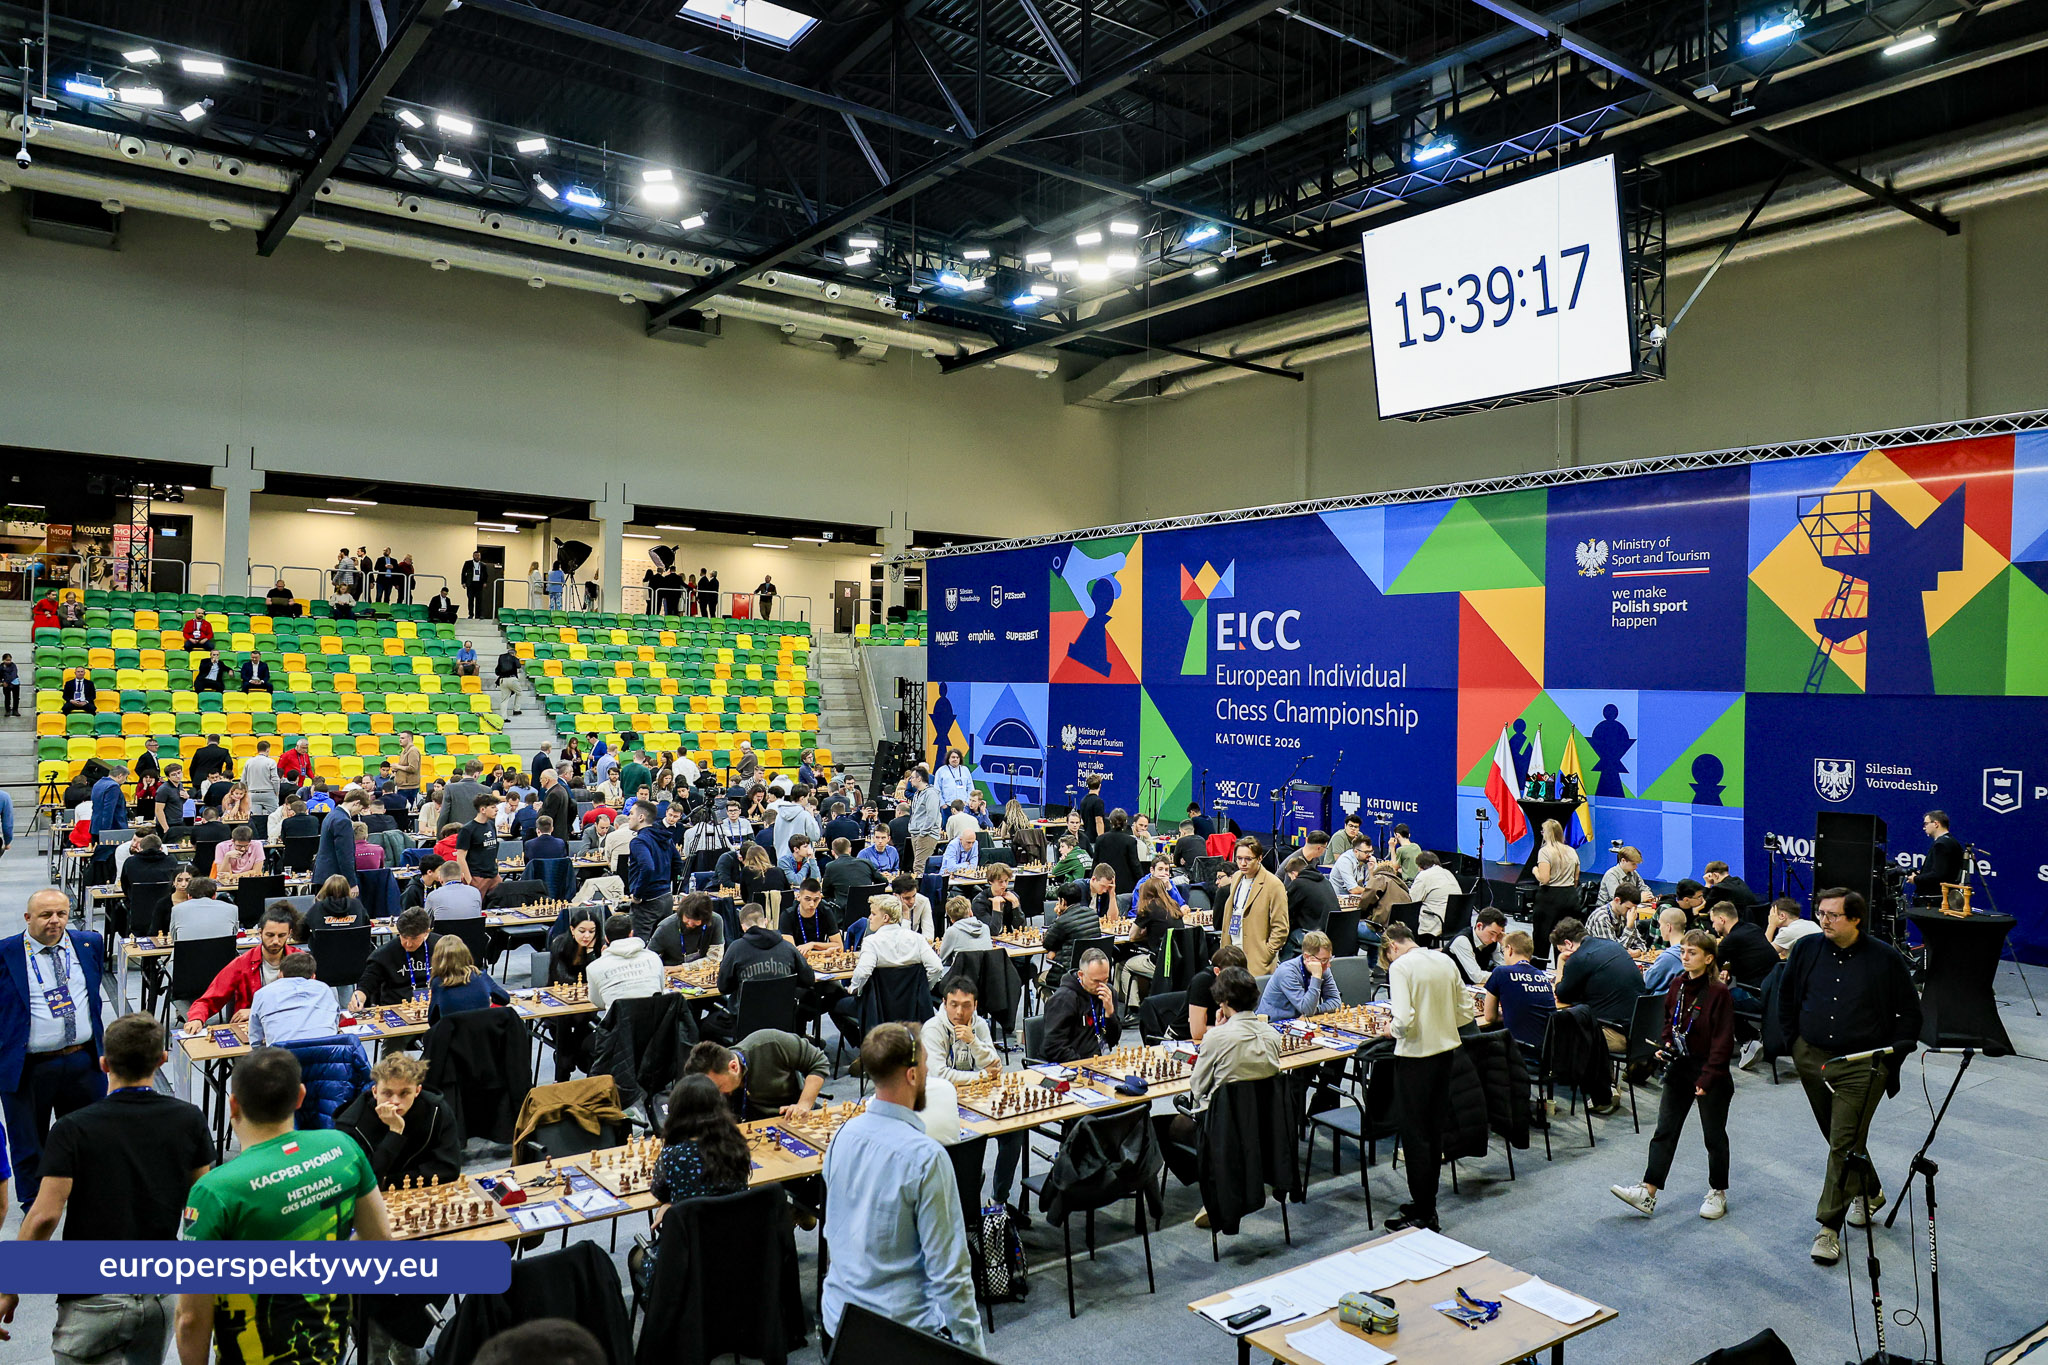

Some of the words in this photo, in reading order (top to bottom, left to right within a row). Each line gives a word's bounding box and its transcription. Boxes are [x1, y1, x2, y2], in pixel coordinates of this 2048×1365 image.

[1395, 243, 1591, 349] 15:39:17
[76, 525, 111, 535] MOKATE
[1612, 538, 1656, 550] Ministry
[1658, 536, 1670, 548] of
[1611, 554, 1641, 567] Sport
[1643, 552, 1663, 563] and
[1666, 549, 1710, 562] Tourism
[1612, 589, 1630, 599] we
[1634, 585, 1667, 598] make
[1612, 600, 1650, 613] Polish
[1653, 599, 1688, 614] sport
[1611, 615, 1657, 629] happen
[1005, 629, 1039, 641] SUPERBET
[1216, 664, 1300, 691] European
[1308, 663, 1406, 687] Individual
[1216, 698, 1267, 721] Chess
[1273, 699, 1419, 734] Championship
[1078, 727, 1099, 737] Ministry
[1100, 728, 1106, 736] of
[1078, 737, 1092, 746] Sport
[1093, 738, 1103, 746] and
[1103, 739, 1123, 747] Tourism
[1215, 733, 1272, 747] KATOWICE
[1274, 737, 1301, 749] 2026
[1078, 761, 1087, 769] we
[1865, 763, 1912, 776] Silesian
[1865, 778, 1938, 794] Voivodeship
[2035, 786, 2048, 799] P
[1367, 798, 1418, 813] KATOWICE
[1510, 972, 1533, 982] UKS
[1521, 983, 1550, 992] Toruń
[249, 1164, 303, 1191] KACPER
[301, 1146, 343, 1172] PIORUN
[287, 1175, 334, 1202] HETMAN
[281, 1201, 300, 1215] GKS
[300, 1183, 342, 1208] KATOWICE
